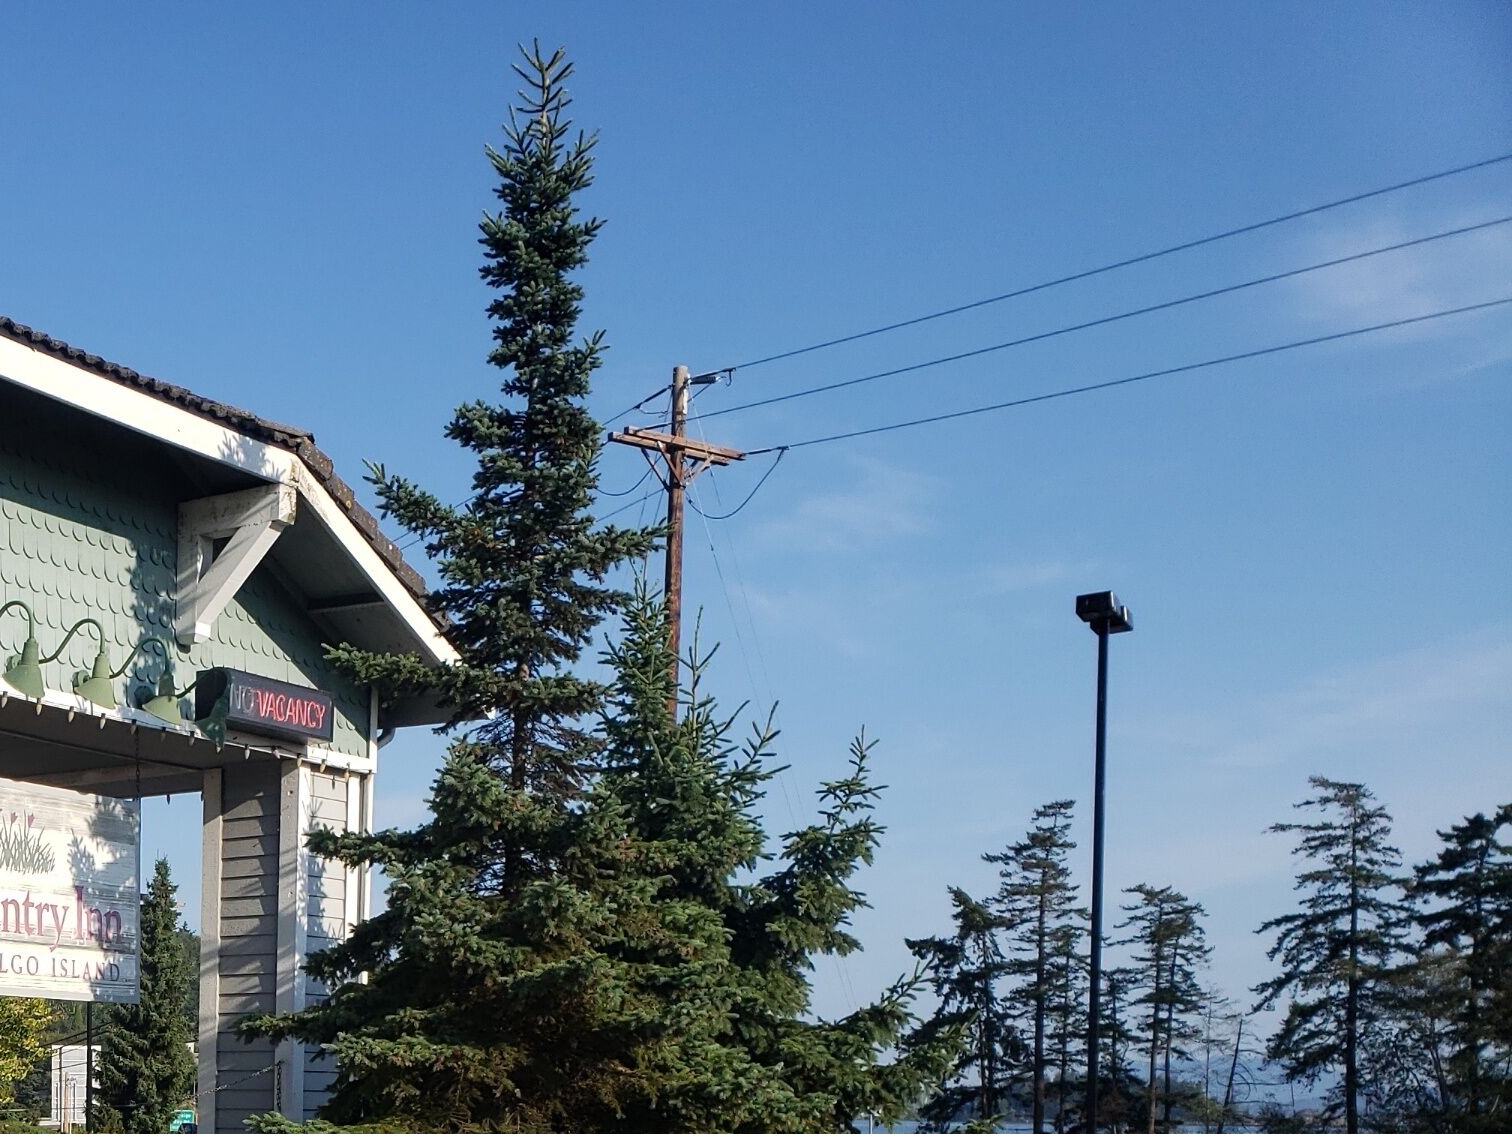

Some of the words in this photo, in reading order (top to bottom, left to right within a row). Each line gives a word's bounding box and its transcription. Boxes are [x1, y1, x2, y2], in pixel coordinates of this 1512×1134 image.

[229, 683, 254, 713] NO
[256, 690, 325, 728] VACANCY
[74, 885, 122, 945] Inn
[52, 959, 120, 982] ISLAND
